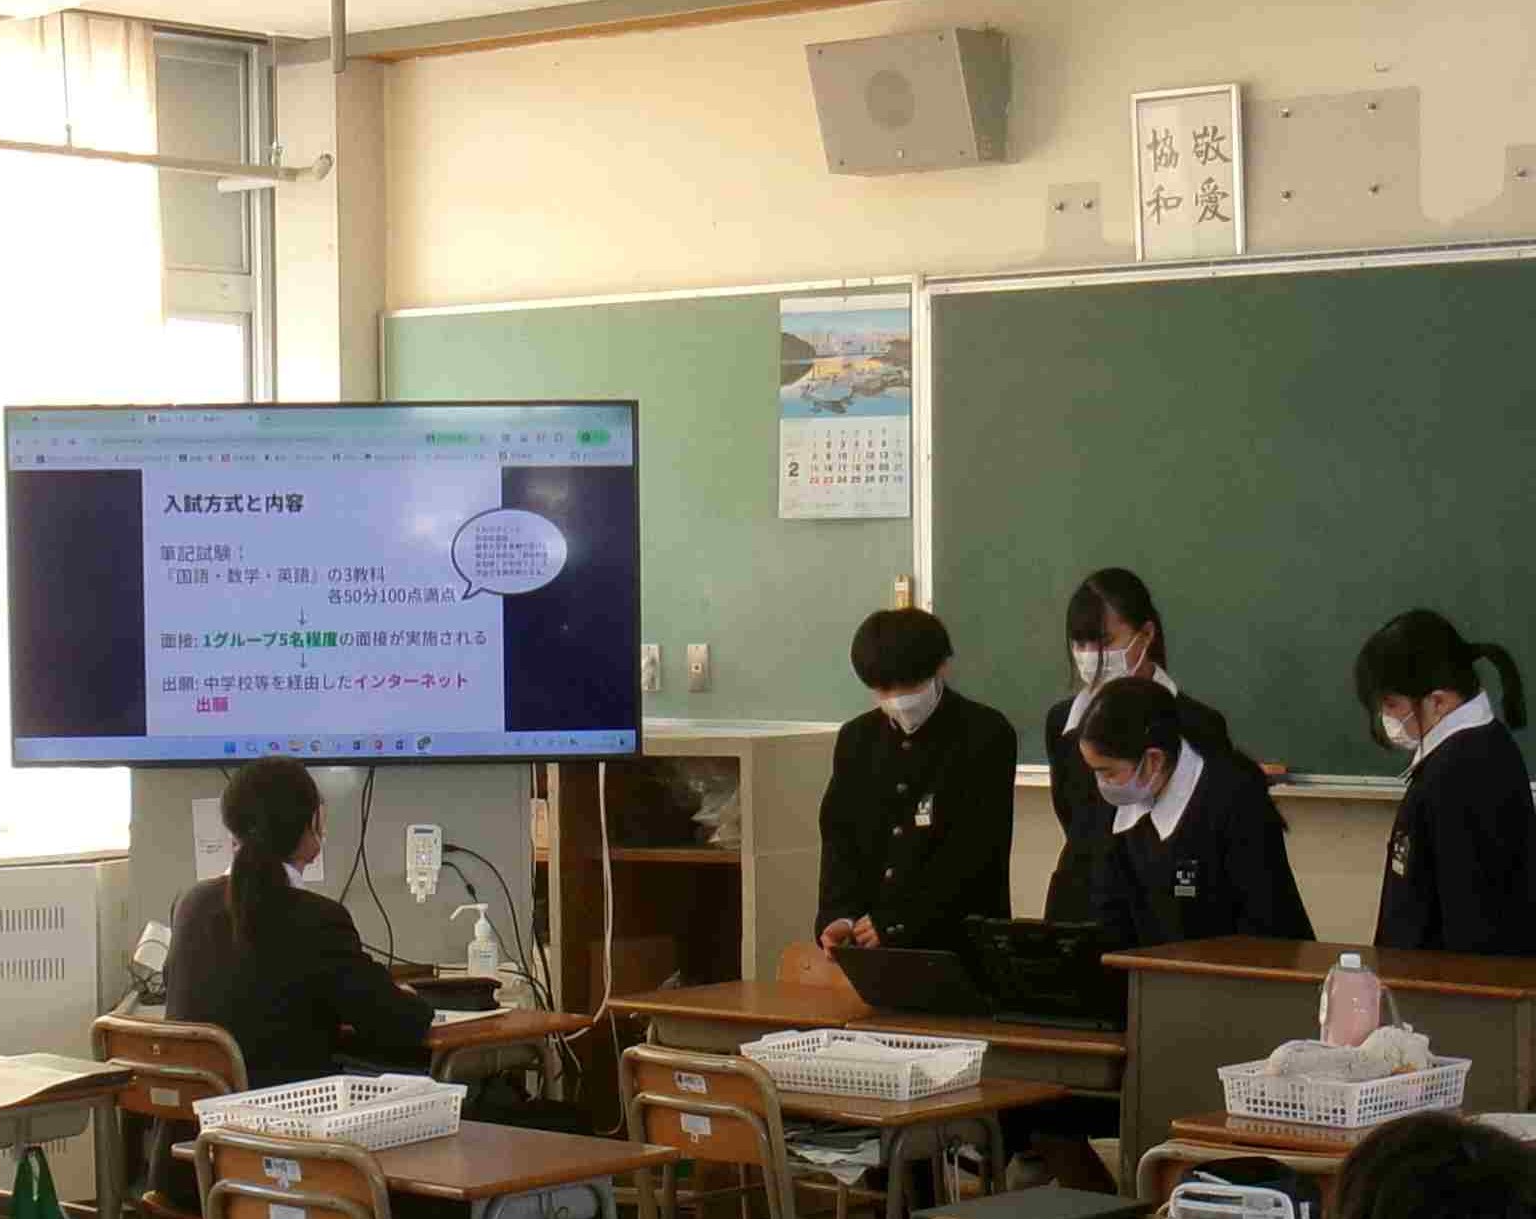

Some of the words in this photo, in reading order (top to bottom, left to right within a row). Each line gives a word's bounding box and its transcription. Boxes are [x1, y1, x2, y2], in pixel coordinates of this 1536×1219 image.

[1146, 129, 1183, 224] 協和
[1192, 125, 1233, 223] 敬愛
[788, 462, 799, 477] 2
[163, 493, 305, 514] 入試方式と内容
